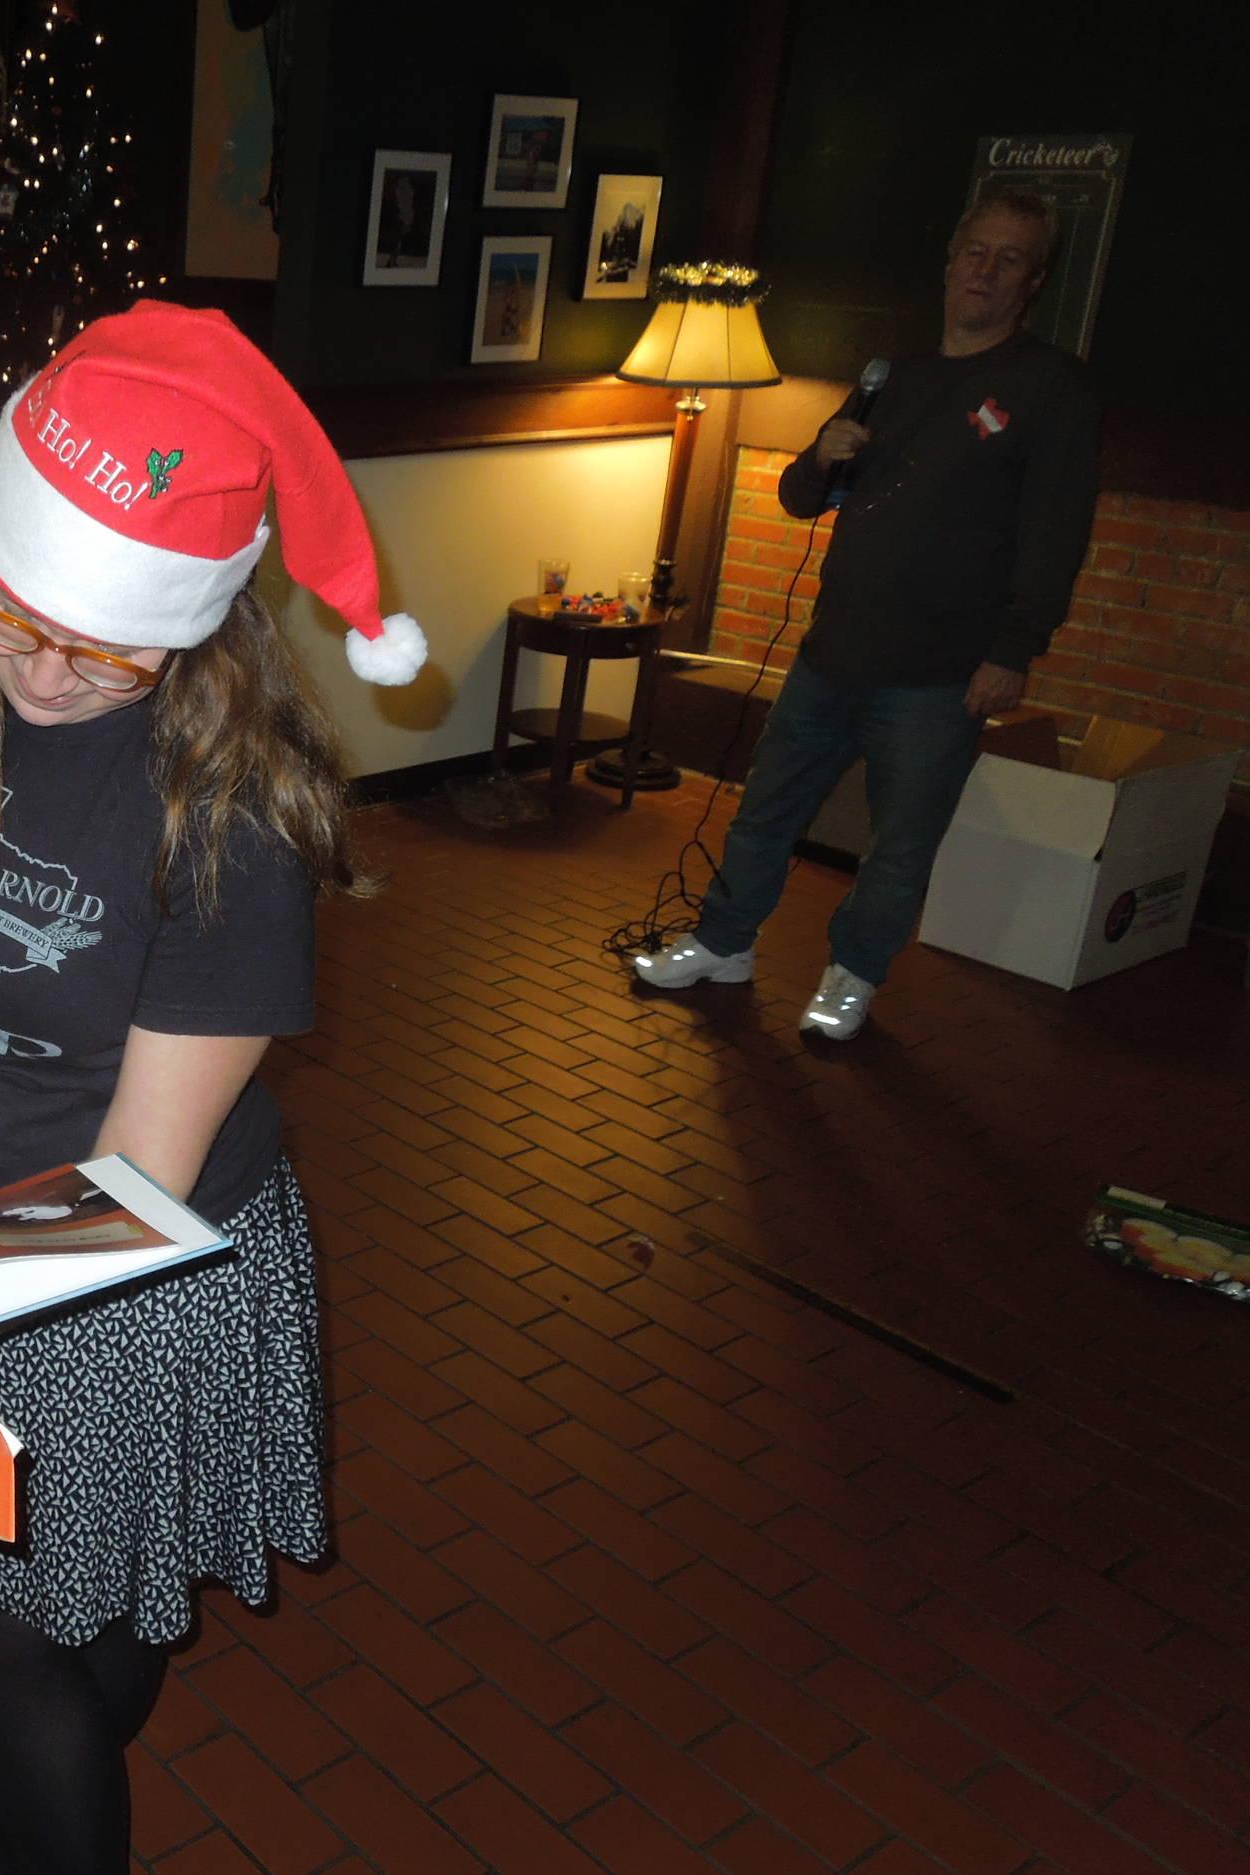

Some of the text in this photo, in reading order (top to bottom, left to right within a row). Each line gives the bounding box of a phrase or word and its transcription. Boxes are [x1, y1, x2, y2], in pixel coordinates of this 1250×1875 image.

[37, 408, 149, 511] Ho! Ho!
[4, 919, 50, 949] BREWERY
